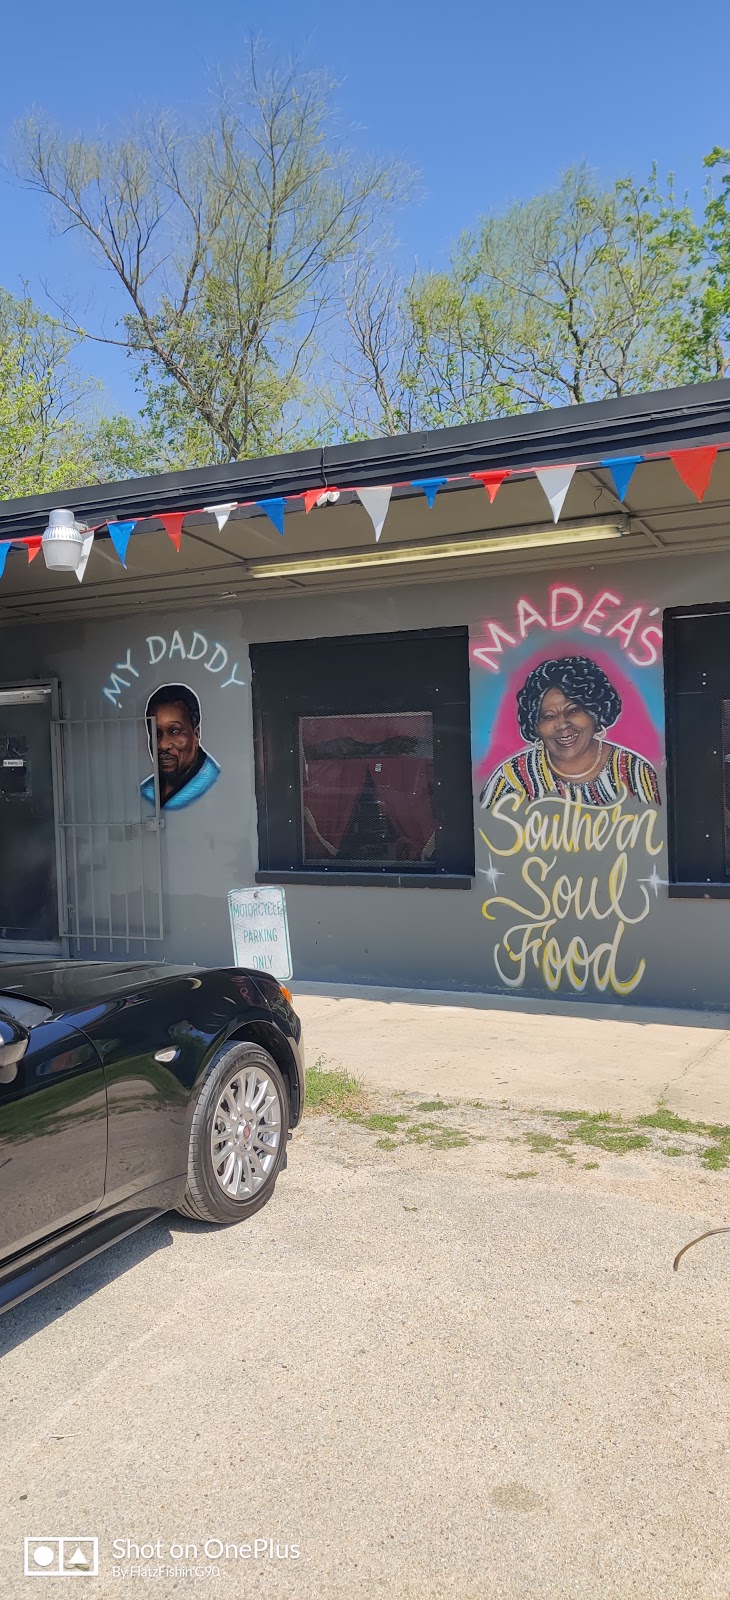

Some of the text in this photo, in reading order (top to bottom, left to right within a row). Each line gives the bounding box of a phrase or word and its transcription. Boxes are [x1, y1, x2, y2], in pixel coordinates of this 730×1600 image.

[473, 587, 663, 670] MADEA'S
[103, 630, 245, 708] MY DADDY
[479, 782, 663, 857] Southern
[233, 901, 283, 917] MOTORCYCLE
[482, 852, 650, 924] Soul
[243, 928, 278, 943] PARKING
[252, 955, 273, 970] ONLY
[494, 918, 646, 995] Food
